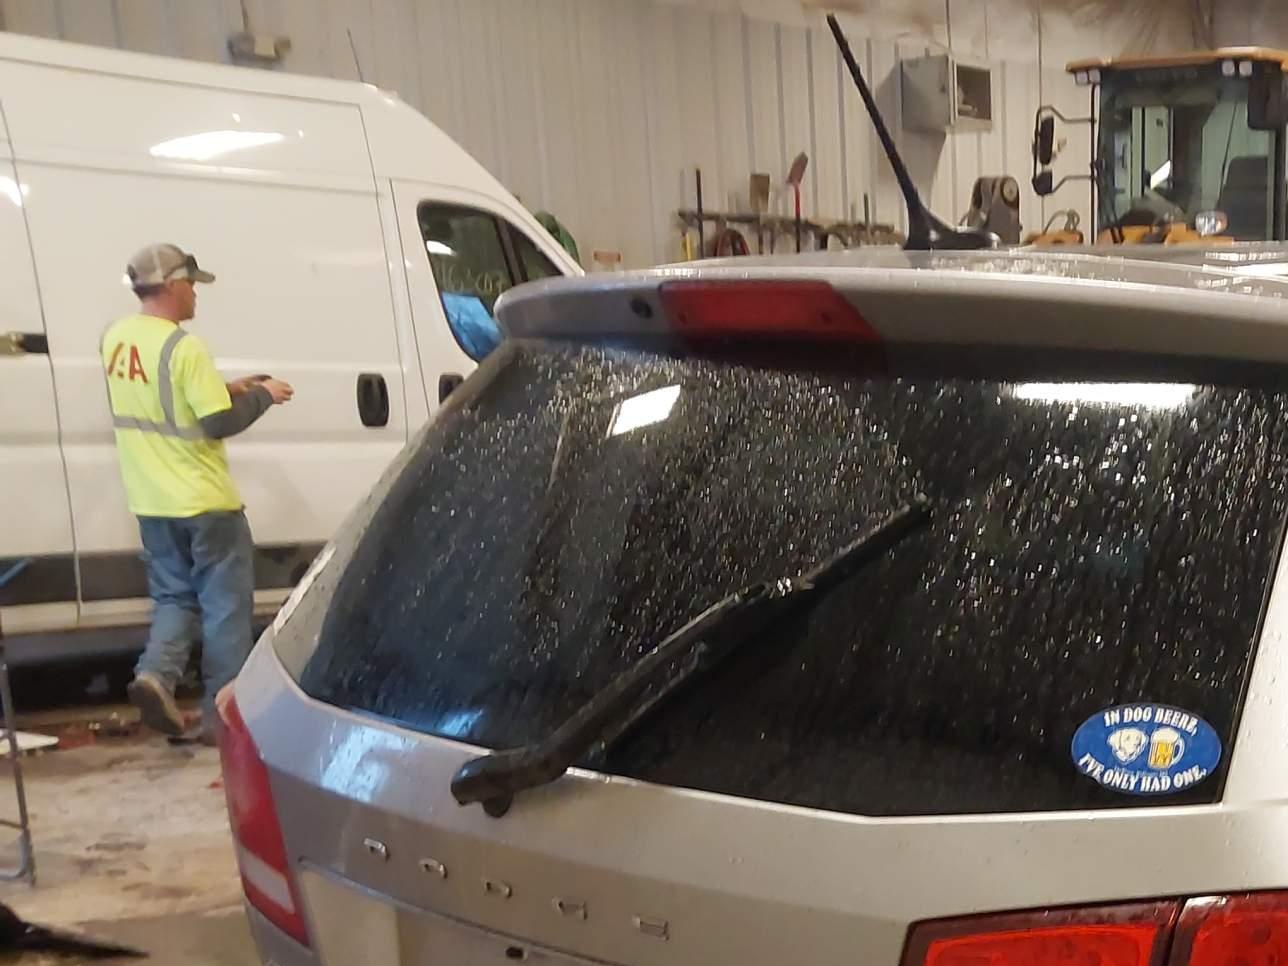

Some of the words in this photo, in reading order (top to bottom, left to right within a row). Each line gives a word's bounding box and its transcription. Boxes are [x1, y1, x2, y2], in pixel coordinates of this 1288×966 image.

[1104, 709, 1120, 727] IN
[1123, 706, 1152, 723] DOG
[1103, 768, 1140, 791] ONLY
[1140, 774, 1171, 792] HAD
